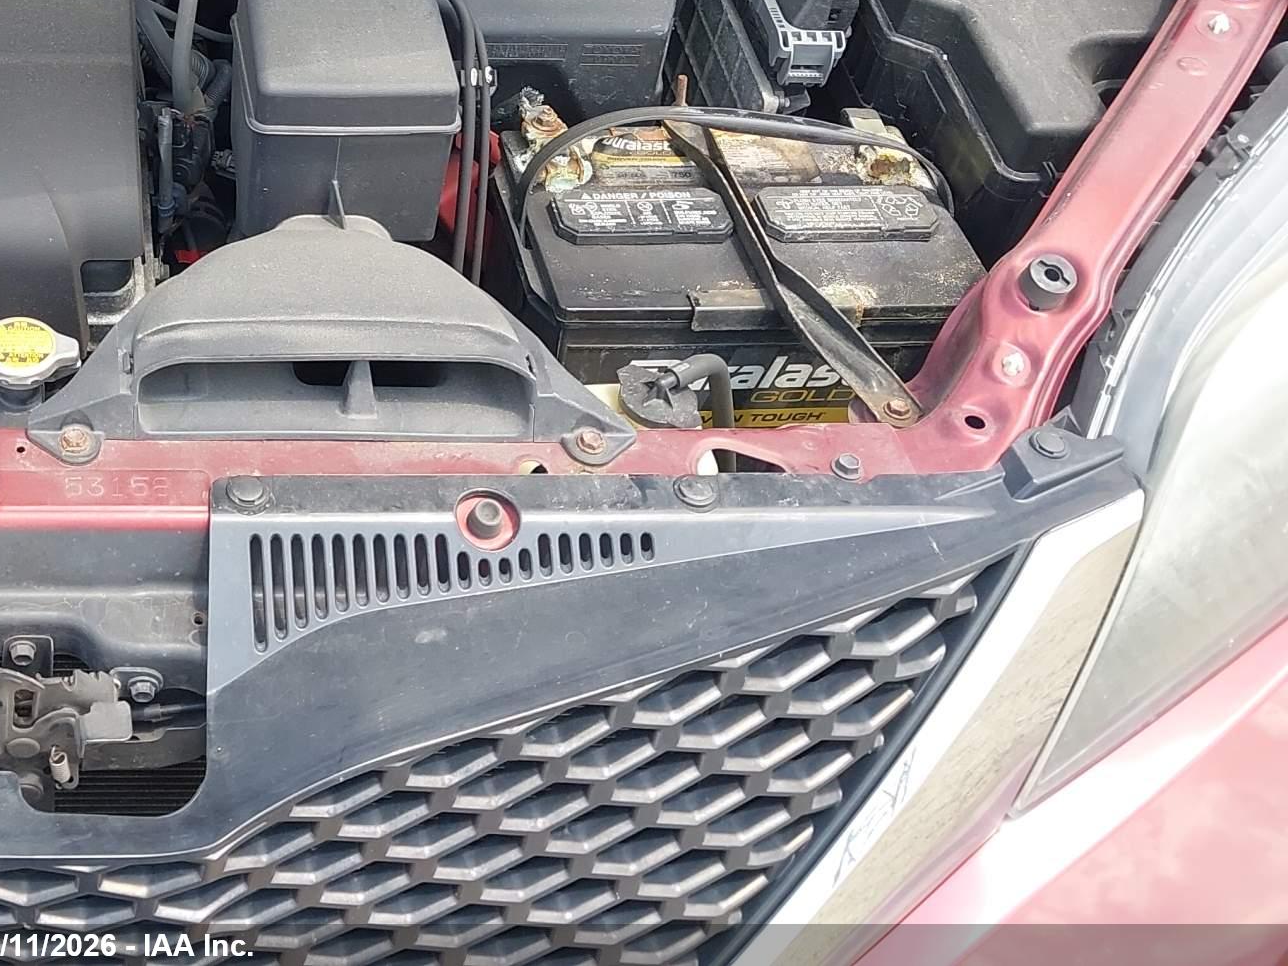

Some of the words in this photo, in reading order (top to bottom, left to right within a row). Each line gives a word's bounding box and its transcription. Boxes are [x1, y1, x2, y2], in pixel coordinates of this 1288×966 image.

[640, 192, 647, 200] /
[750, 389, 856, 403] GOLD
[752, 412, 821, 423] TOUGH
